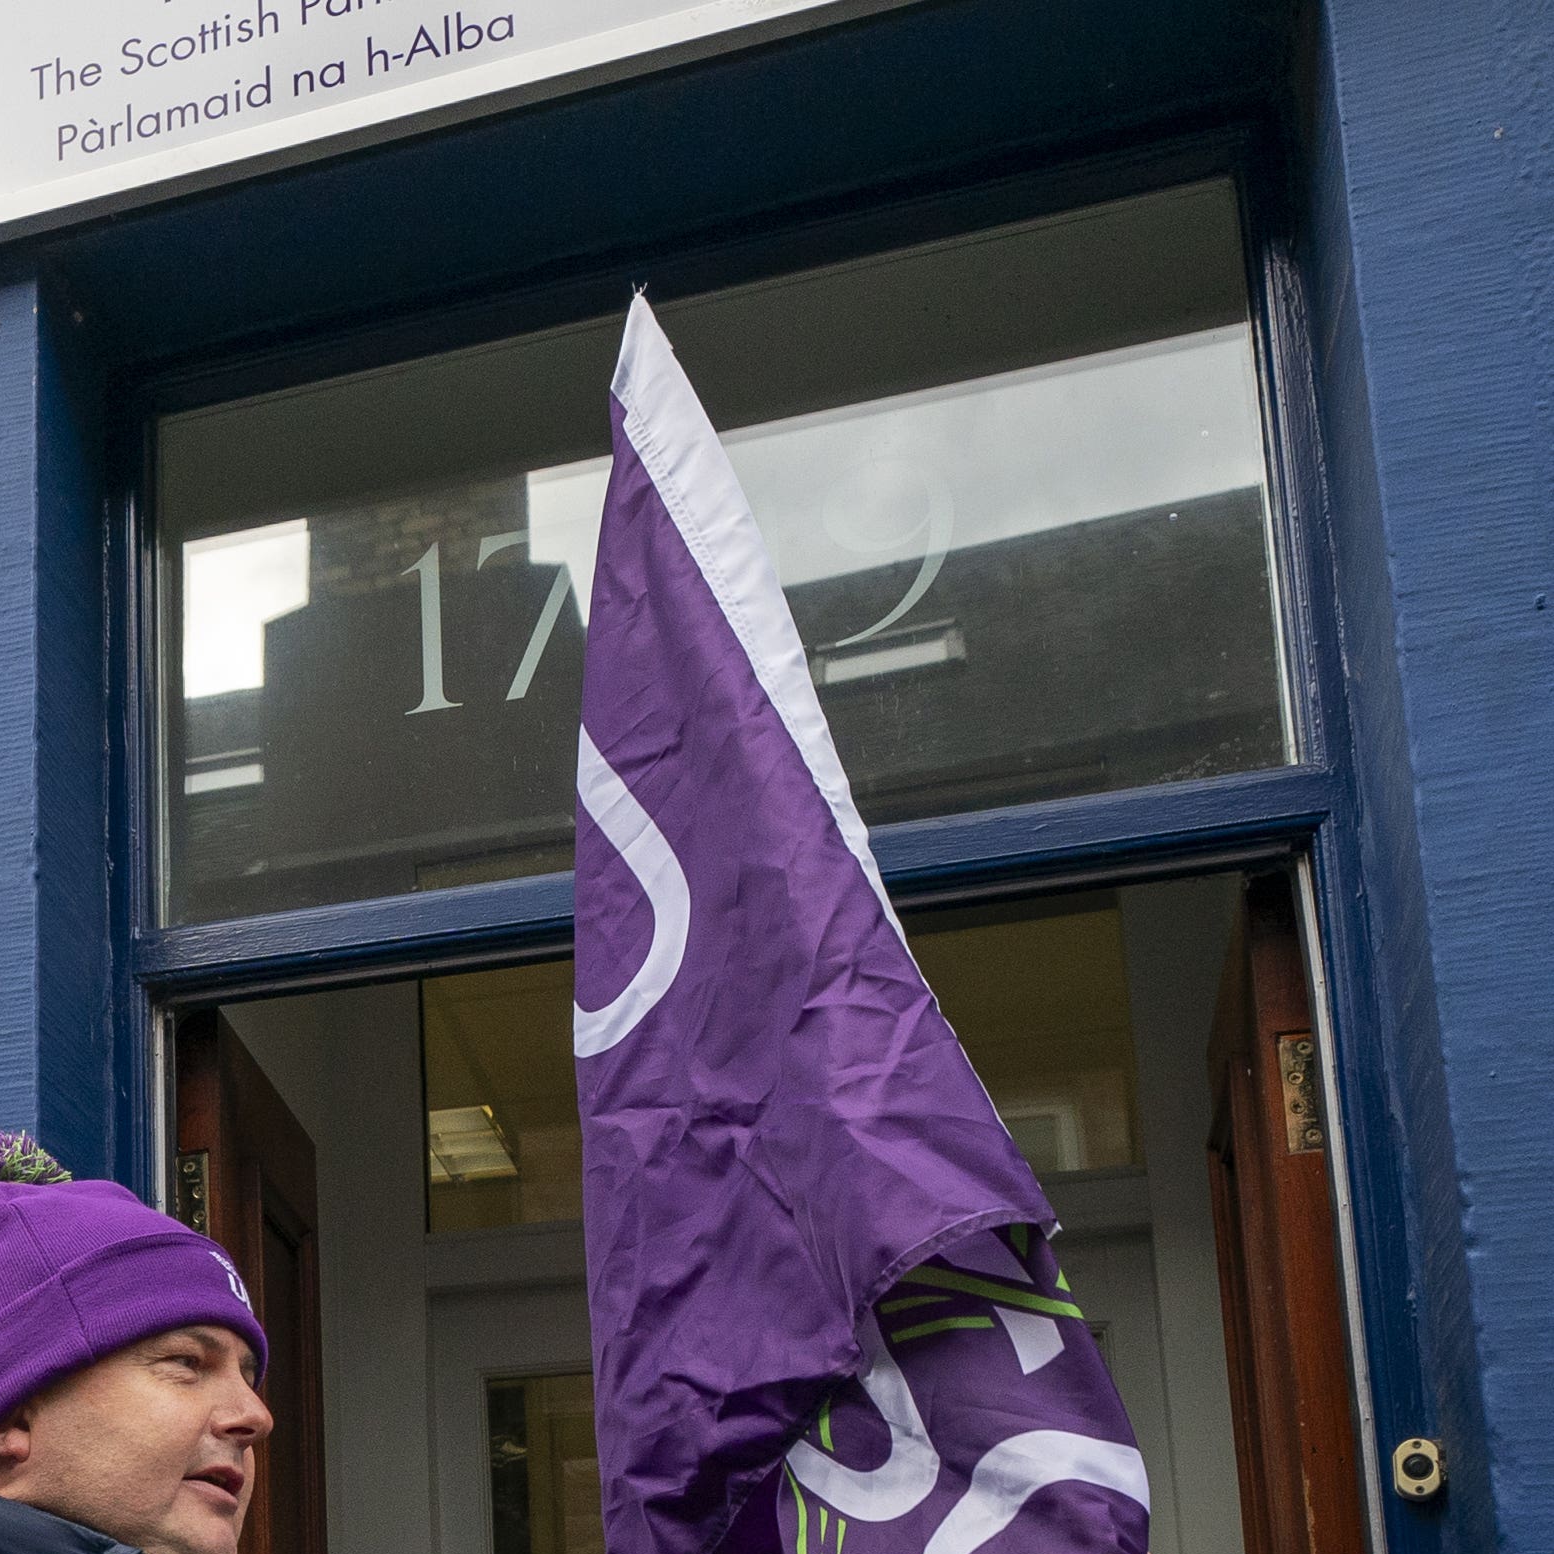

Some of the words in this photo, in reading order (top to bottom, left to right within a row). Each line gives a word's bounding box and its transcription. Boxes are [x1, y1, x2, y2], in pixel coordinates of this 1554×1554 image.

[29, 58, 102, 100] The
[120, 0, 279, 75] Scottish
[56, 65, 272, 161] Pàrlamaid
[293, 60, 345, 97] na
[367, 11, 514, 76] h-Alba
